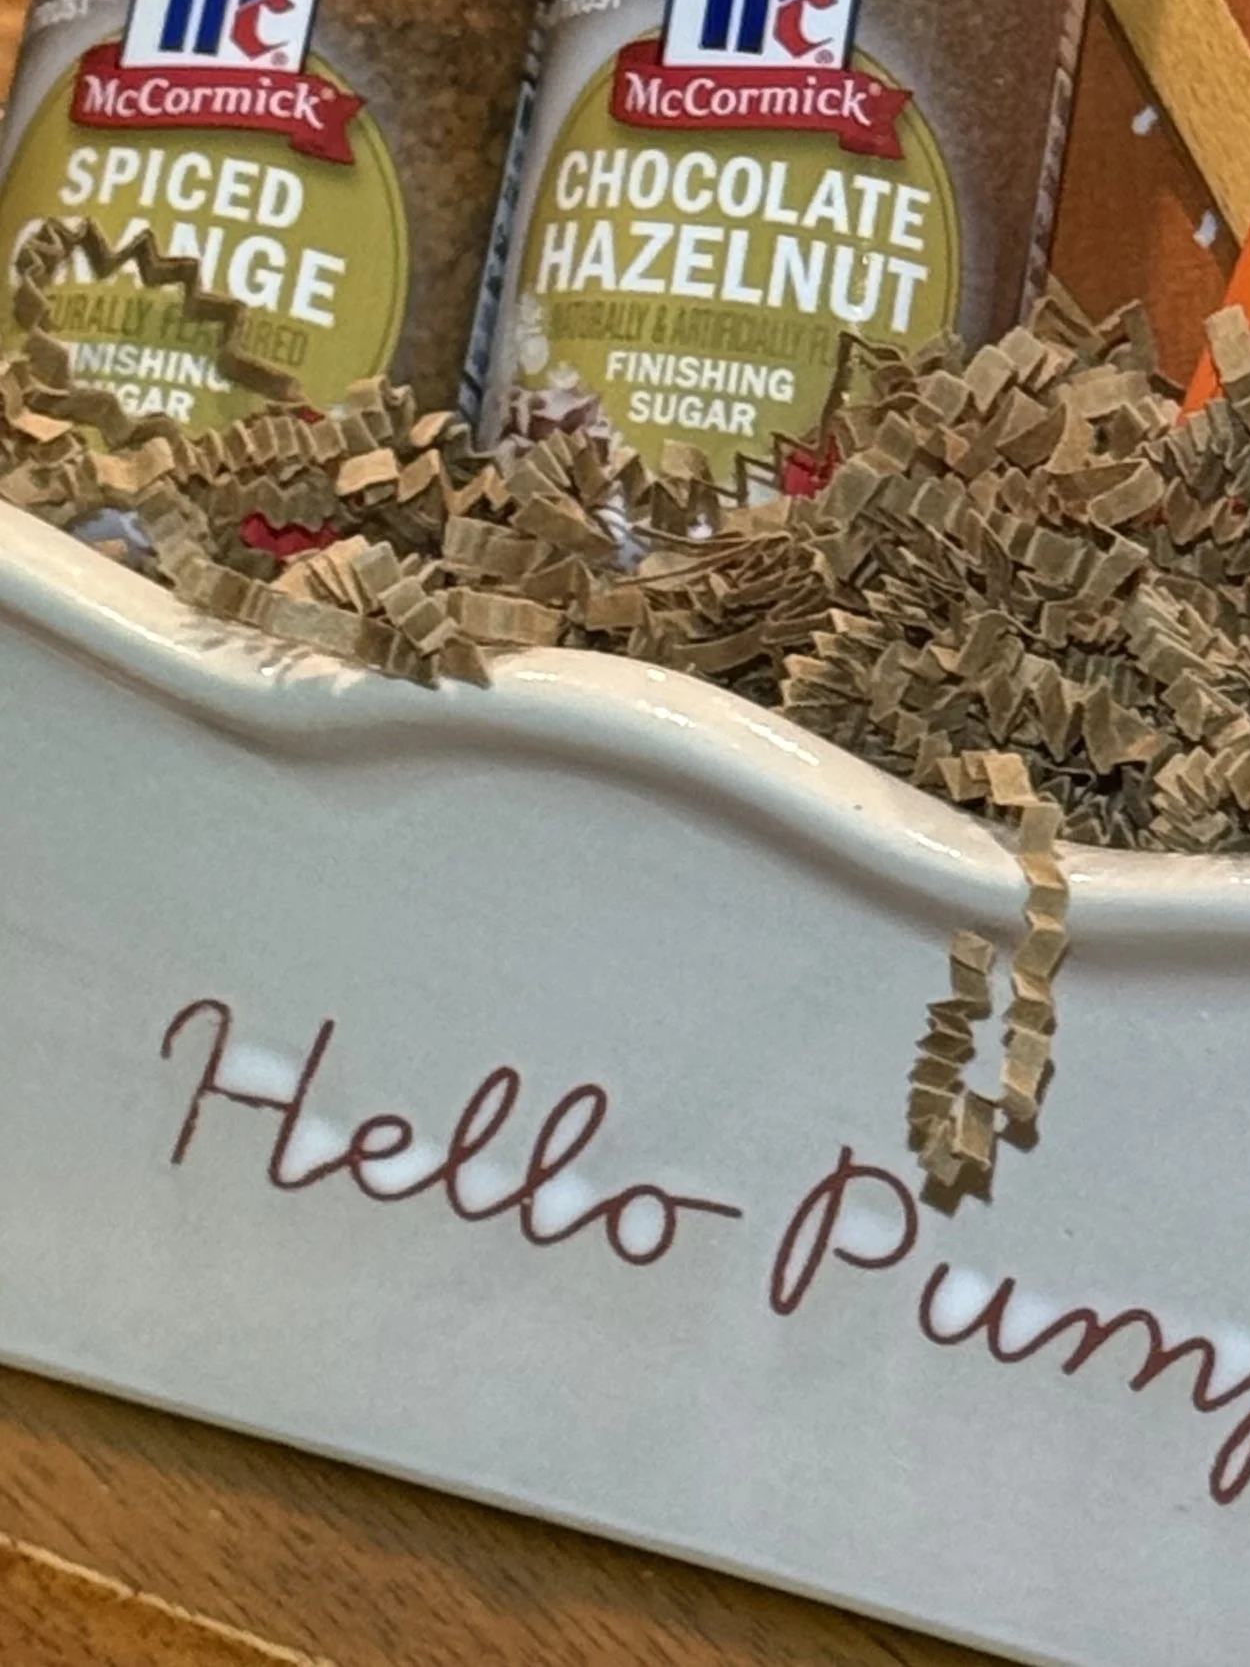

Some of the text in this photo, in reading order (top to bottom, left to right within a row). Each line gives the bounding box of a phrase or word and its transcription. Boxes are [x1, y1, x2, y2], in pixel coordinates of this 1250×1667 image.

[82, 75, 324, 130] McCormick
[624, 72, 871, 126] McCormick
[58, 146, 304, 228] SPICED
[556, 149, 931, 251] CHOCOLATE
[535, 220, 927, 334] HAZELNUT
[74, 380, 196, 425] GAR
[605, 351, 794, 403] FINISHING
[628, 390, 757, 437] SUGAR
[160, 998, 743, 1265] Hello
